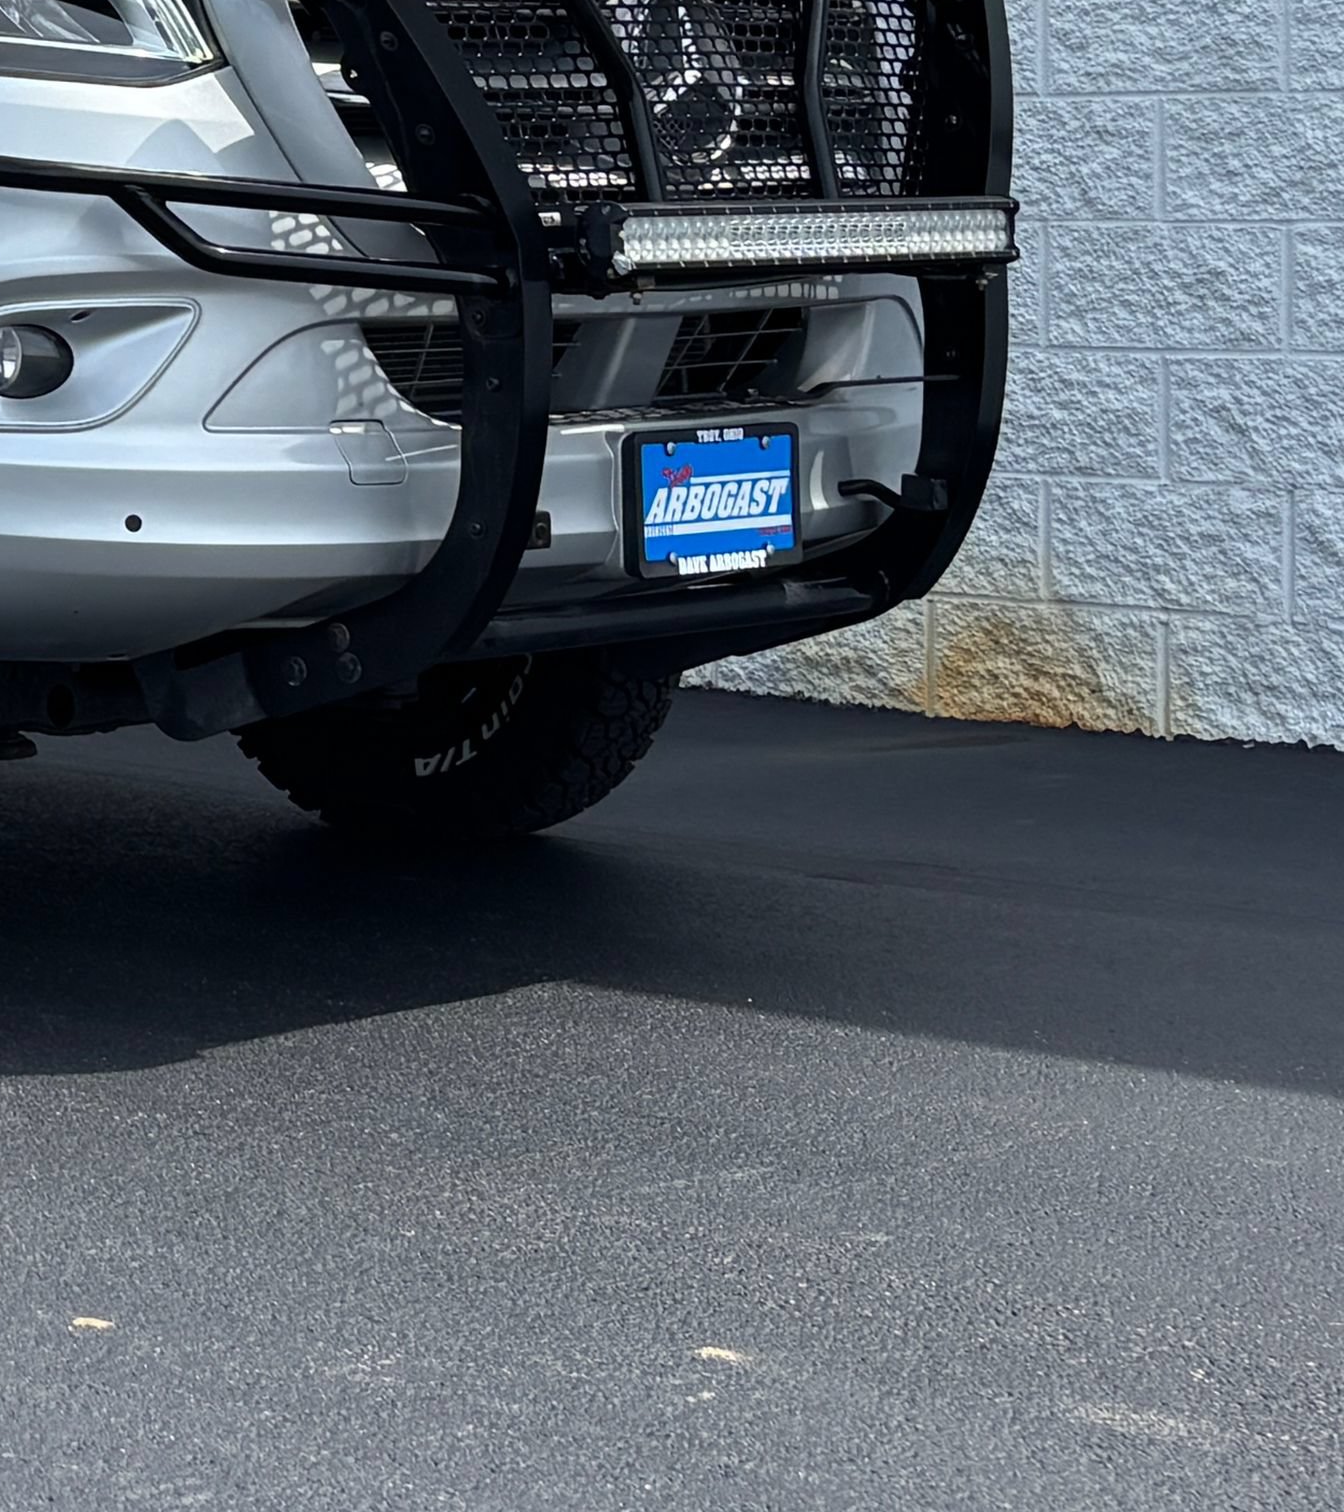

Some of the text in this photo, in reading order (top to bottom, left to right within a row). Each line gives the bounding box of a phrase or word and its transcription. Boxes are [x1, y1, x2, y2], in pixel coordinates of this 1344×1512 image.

[644, 477, 790, 525] ARBOGAST
[678, 549, 768, 575] DAVE ARBOGAST
[414, 738, 479, 778] T/A
